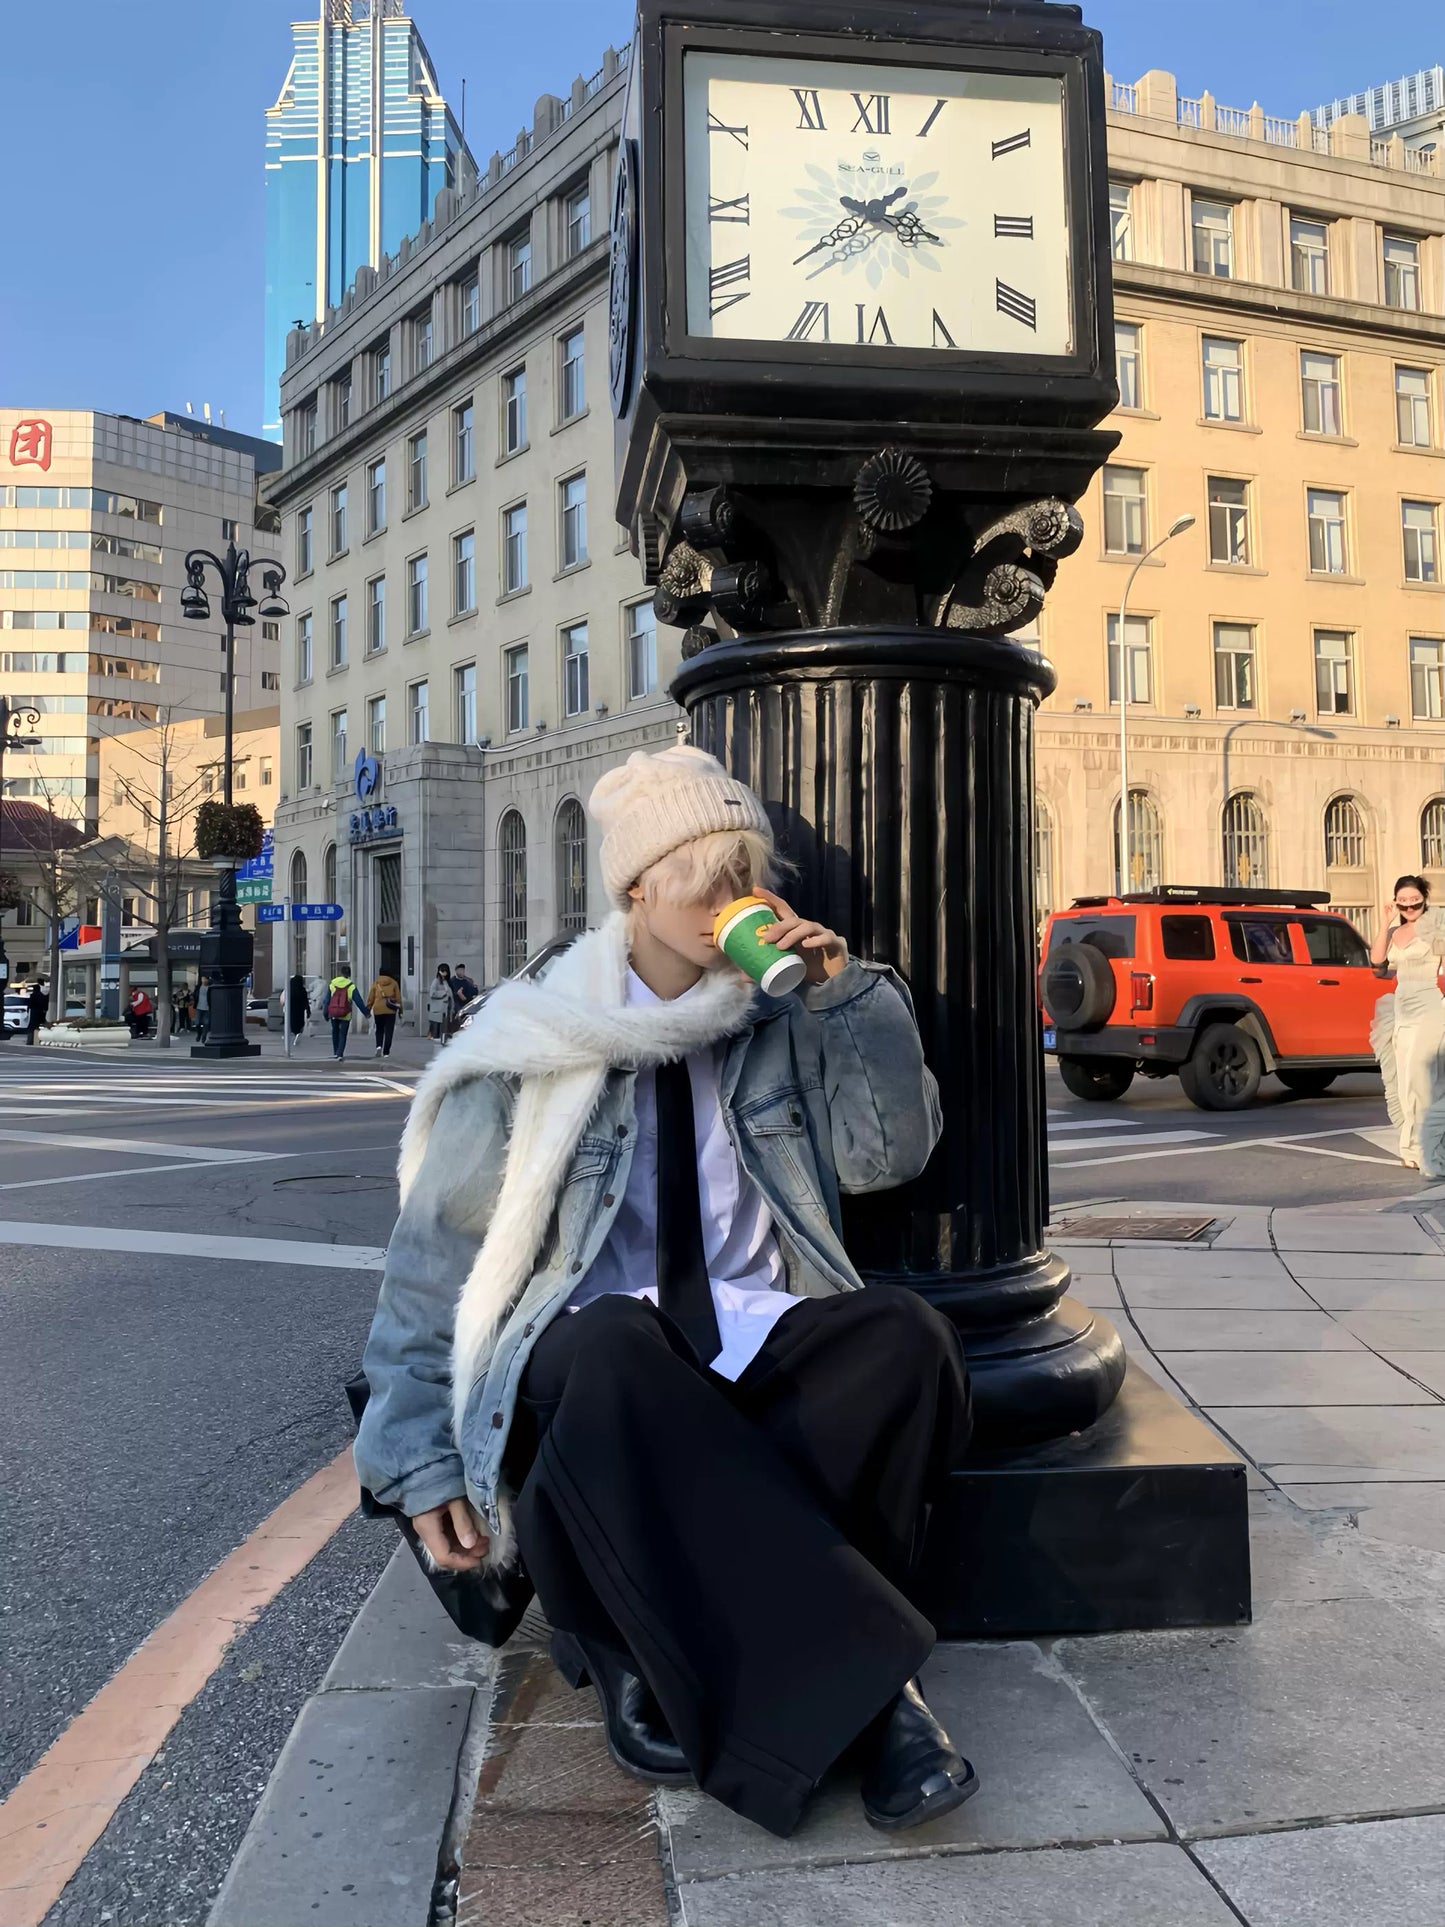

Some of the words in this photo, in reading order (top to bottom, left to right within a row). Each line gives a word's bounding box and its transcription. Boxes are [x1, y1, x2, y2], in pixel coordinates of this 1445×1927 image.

[790, 88, 827, 130] XI
[850, 93, 891, 135] XII
[838, 164, 904, 175] SEA-GULL
[994, 213, 1034, 240] III
[9, 418, 53, 472] 团
